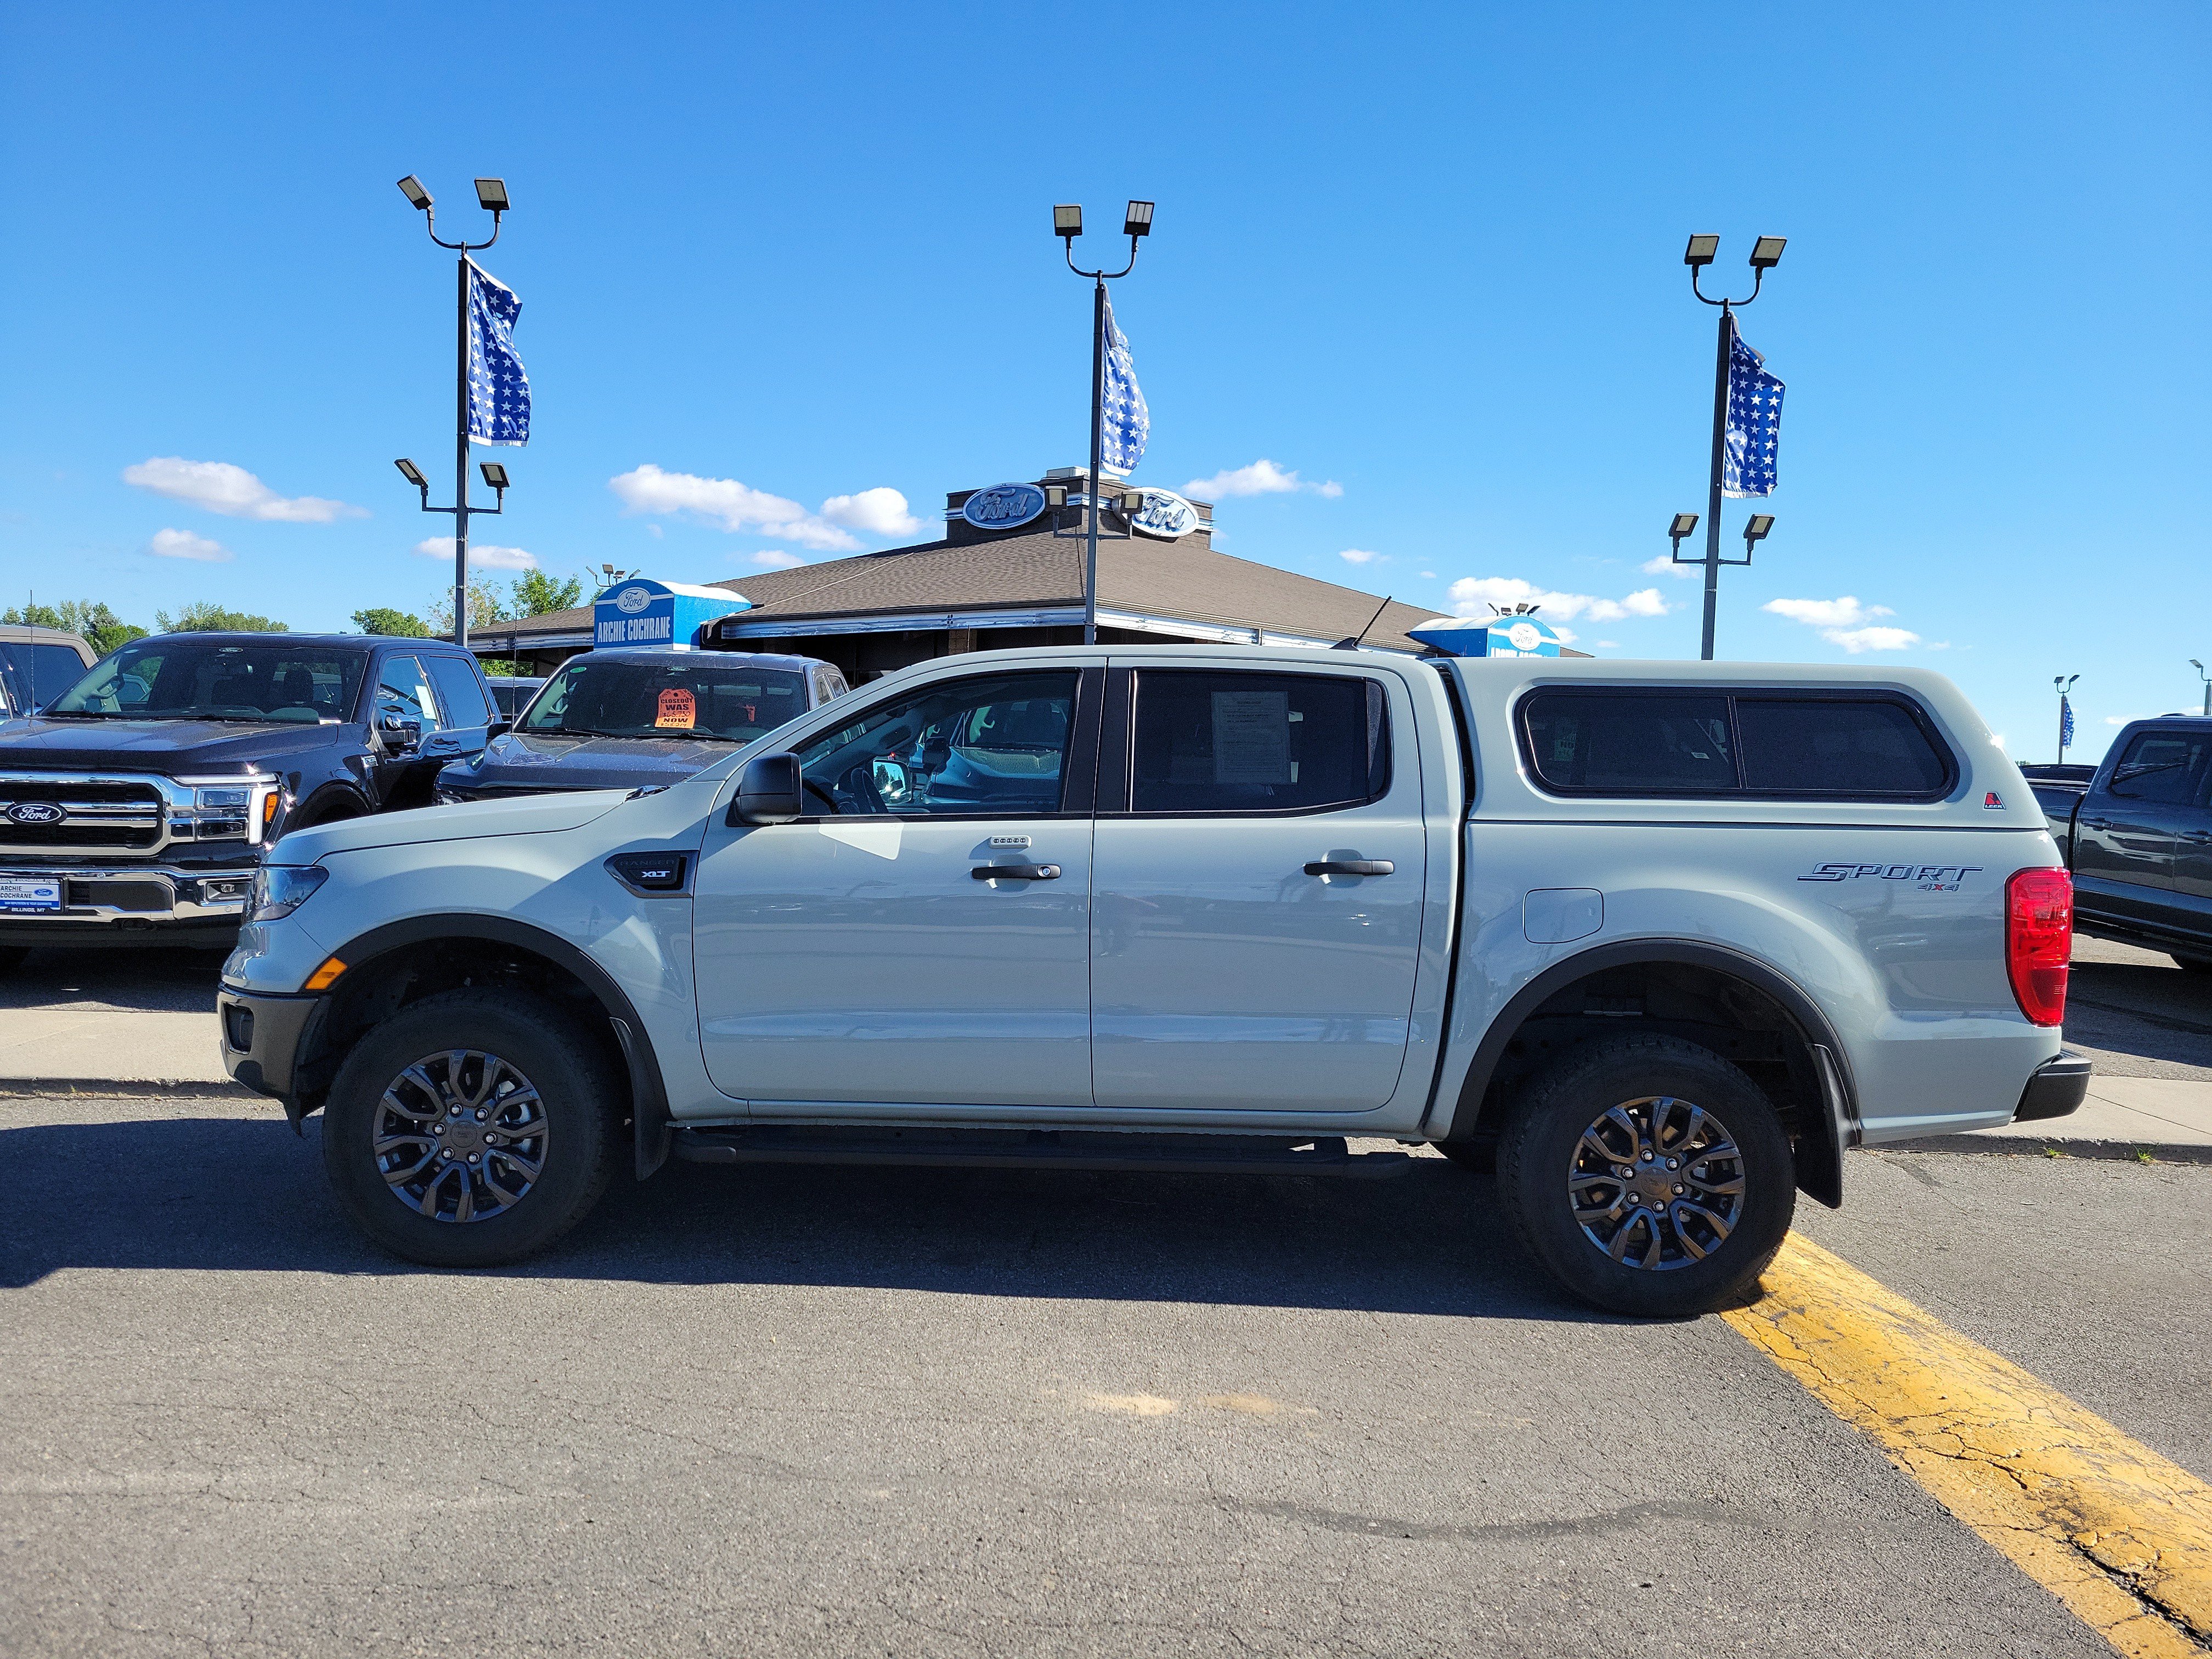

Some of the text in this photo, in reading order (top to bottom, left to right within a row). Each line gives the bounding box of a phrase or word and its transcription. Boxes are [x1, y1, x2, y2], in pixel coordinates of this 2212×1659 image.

[975, 489, 1029, 521] Ford
[1132, 494, 1186, 528] Ford
[623, 591, 643, 607] Ford
[597, 617, 670, 642] ARCHIE COCHRANE
[19, 806, 52, 820] Ford
[1797, 862, 1984, 882] SPORT
